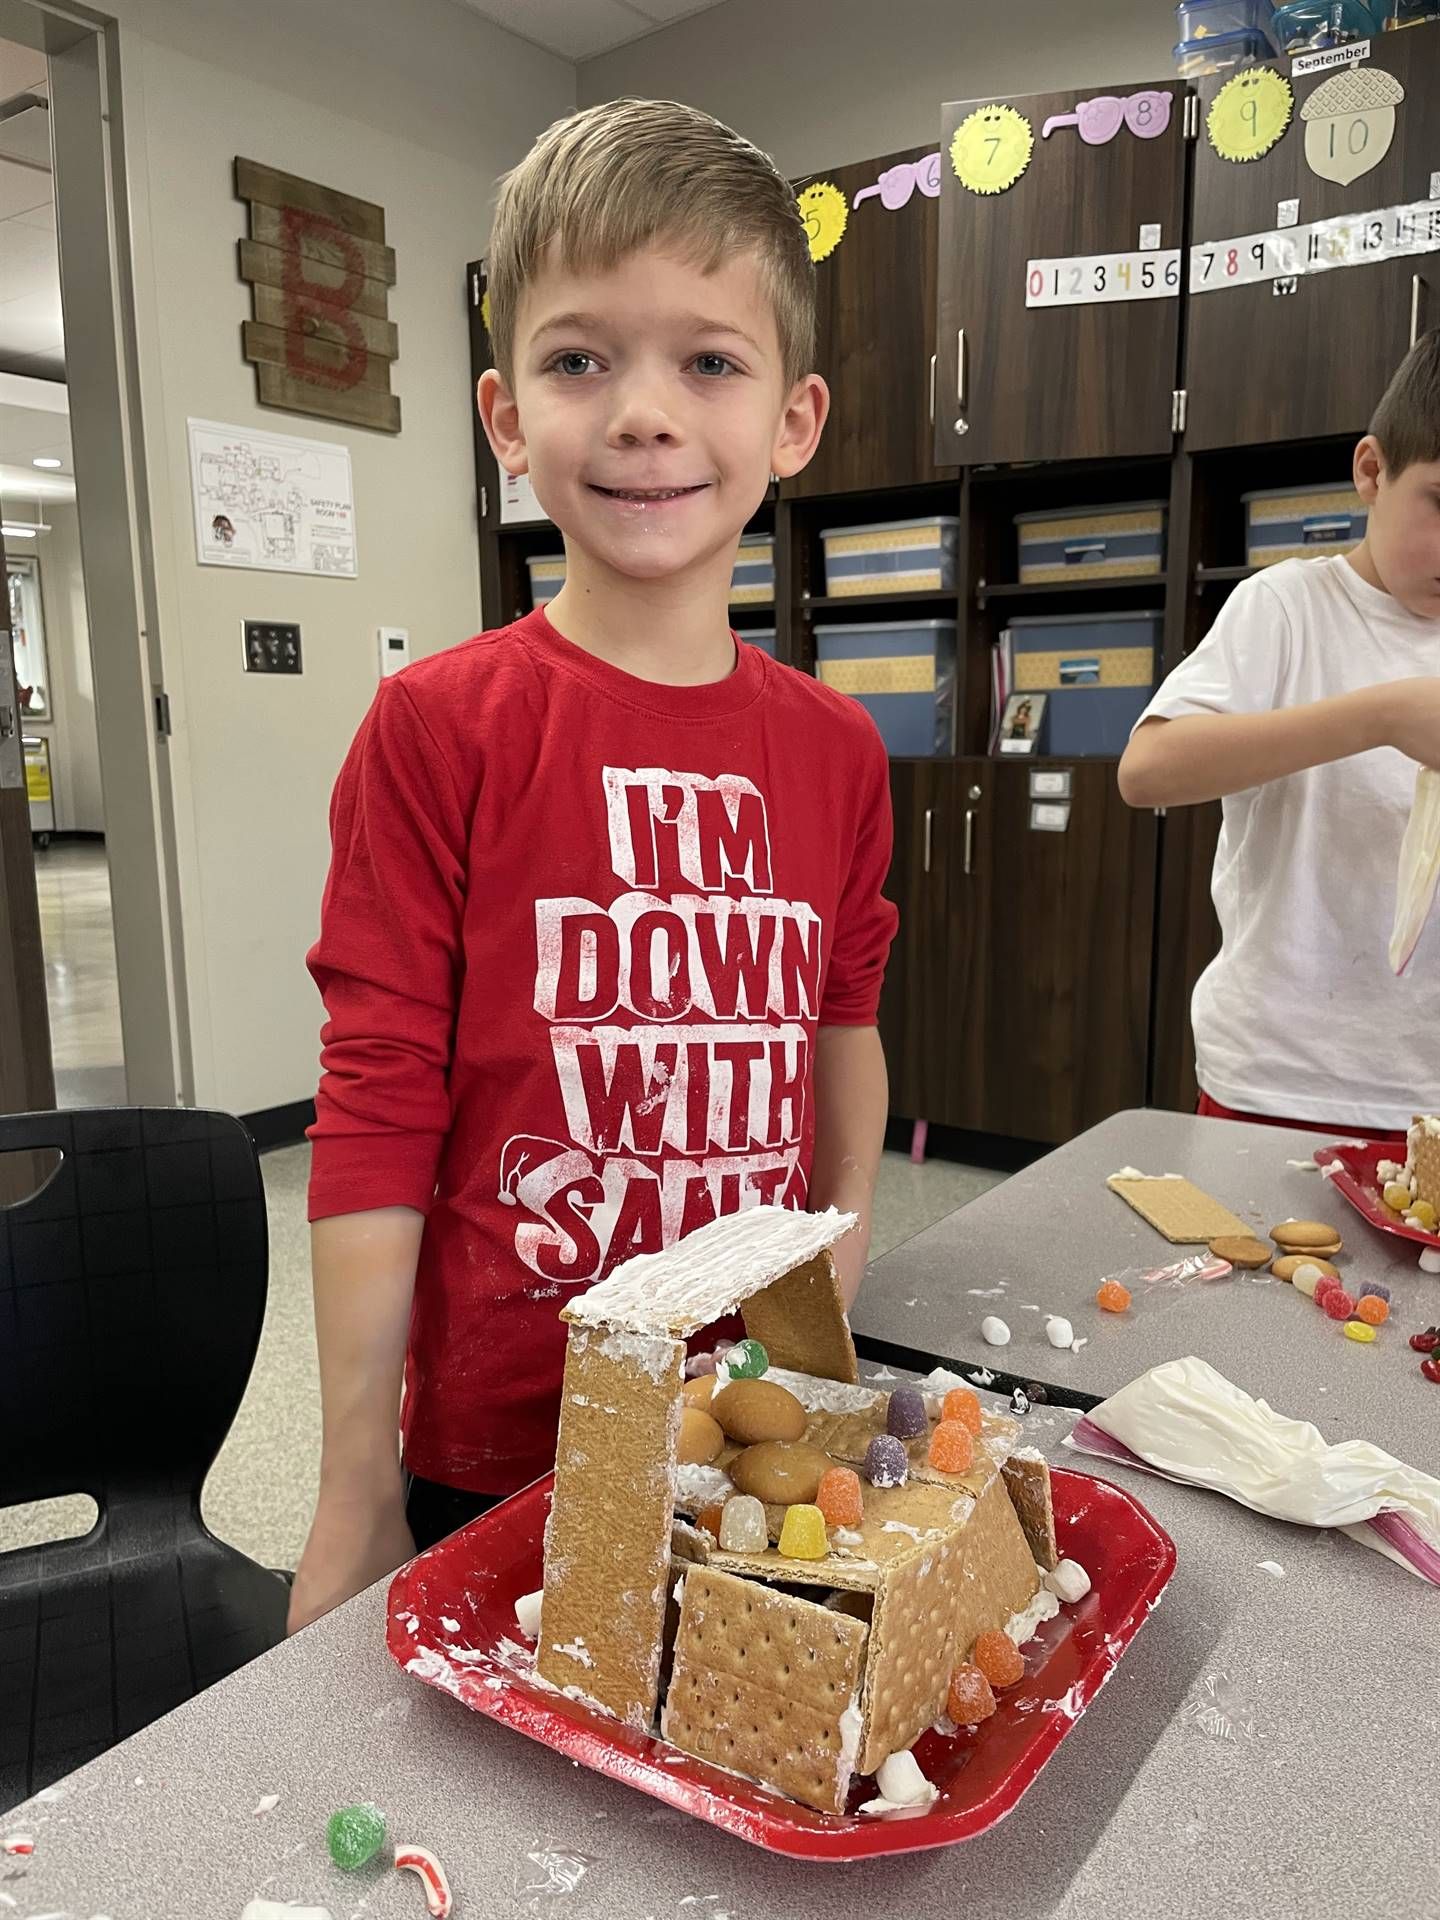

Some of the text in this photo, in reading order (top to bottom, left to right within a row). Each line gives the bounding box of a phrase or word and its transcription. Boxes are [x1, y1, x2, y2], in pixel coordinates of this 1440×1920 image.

[1298, 45, 1367, 71] September
[1136, 100, 1152, 126] 8
[1240, 100, 1256, 137] 9
[984, 138, 1001, 165] 7
[1330, 119, 1368, 158] 10
[927, 160, 940, 188] 6
[806, 209, 821, 240] 5
[1202, 253, 1215, 280] 7
[1226, 249, 1239, 276] 8
[1252, 243, 1265, 270] 9
[1308, 234, 1319, 261] 11
[1363, 222, 1383, 250] 13
[1029, 260, 1178, 297] 0 1 2 3 4 5 6
[280, 204, 368, 391] B
[604, 766, 774, 893] I'M
[533, 893, 822, 1021] DOWN
[550, 1024, 808, 1156] WITH
